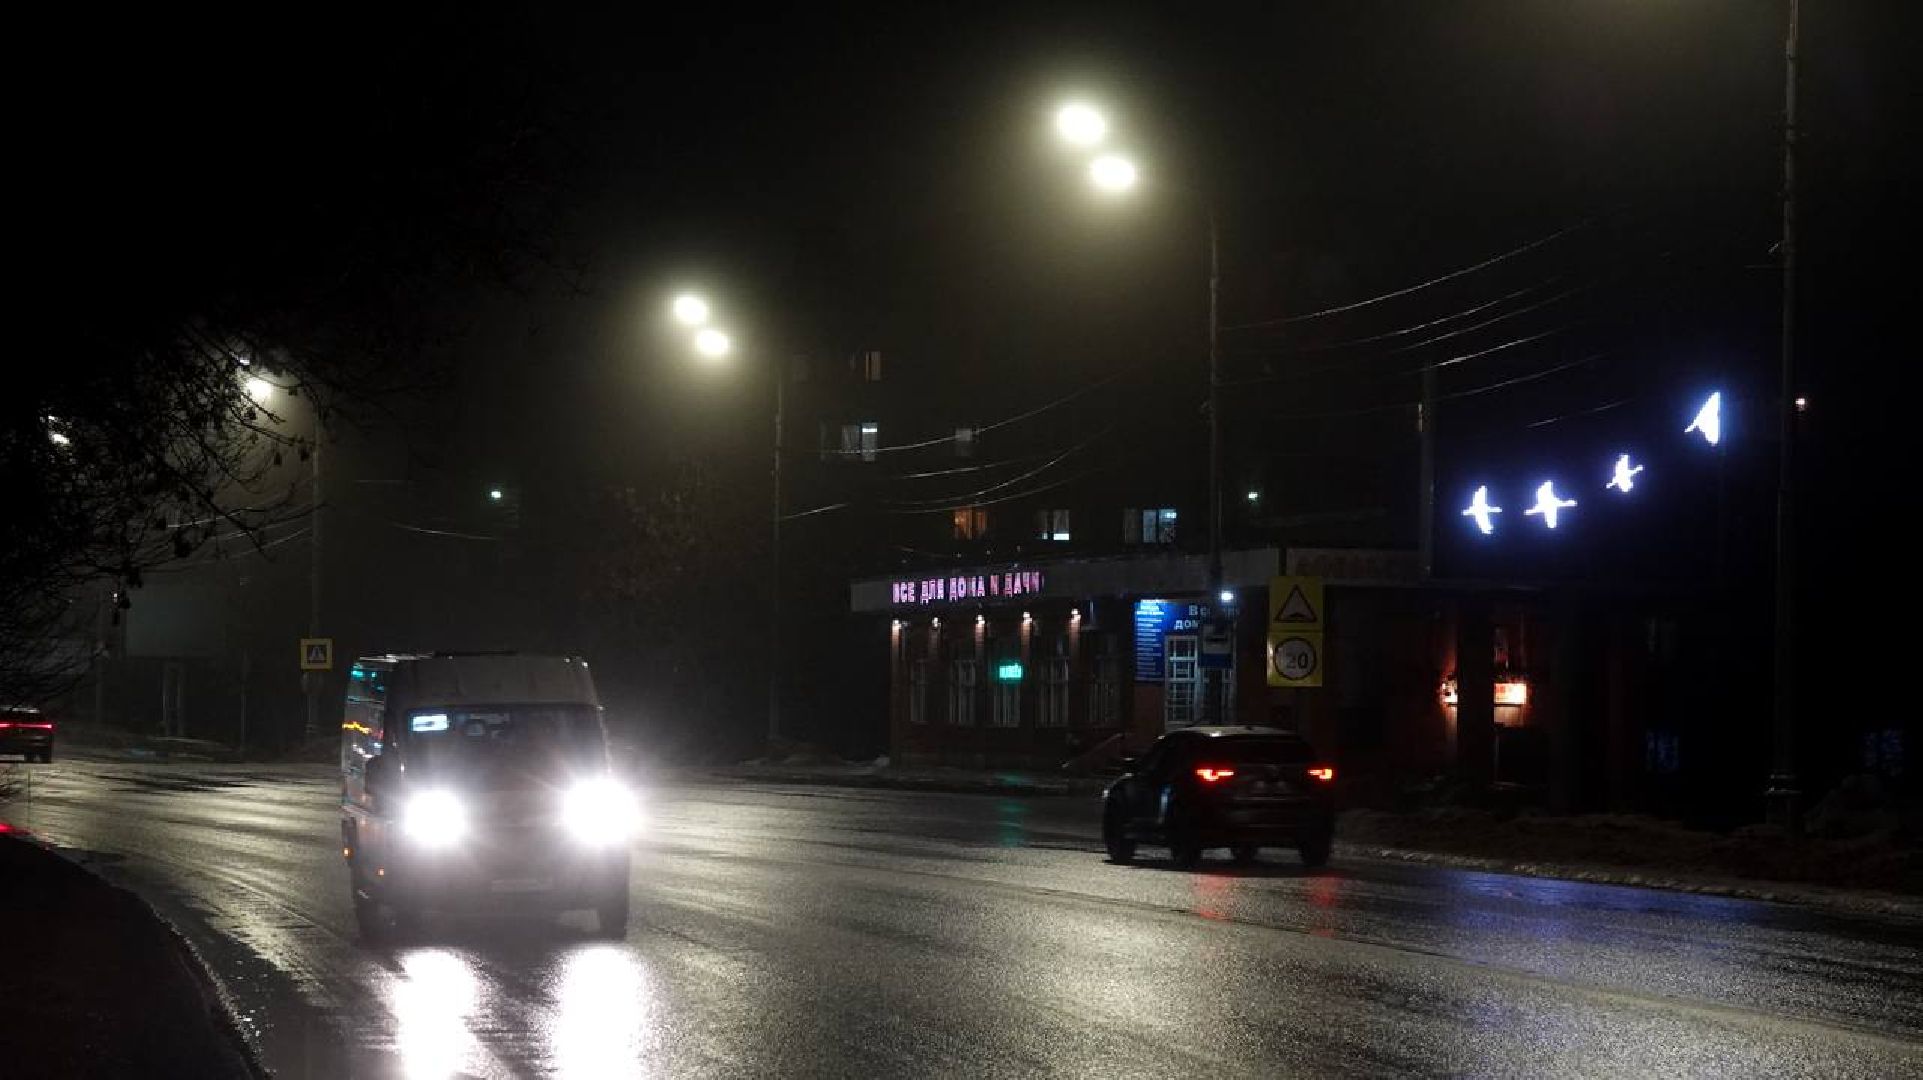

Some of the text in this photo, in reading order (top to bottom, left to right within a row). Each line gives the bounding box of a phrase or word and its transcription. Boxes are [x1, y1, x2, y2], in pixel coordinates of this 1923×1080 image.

[893, 582, 915, 603] ВСЕ
[920, 579, 944, 605] ДЛЯ
[1286, 651, 1309, 669] 20
